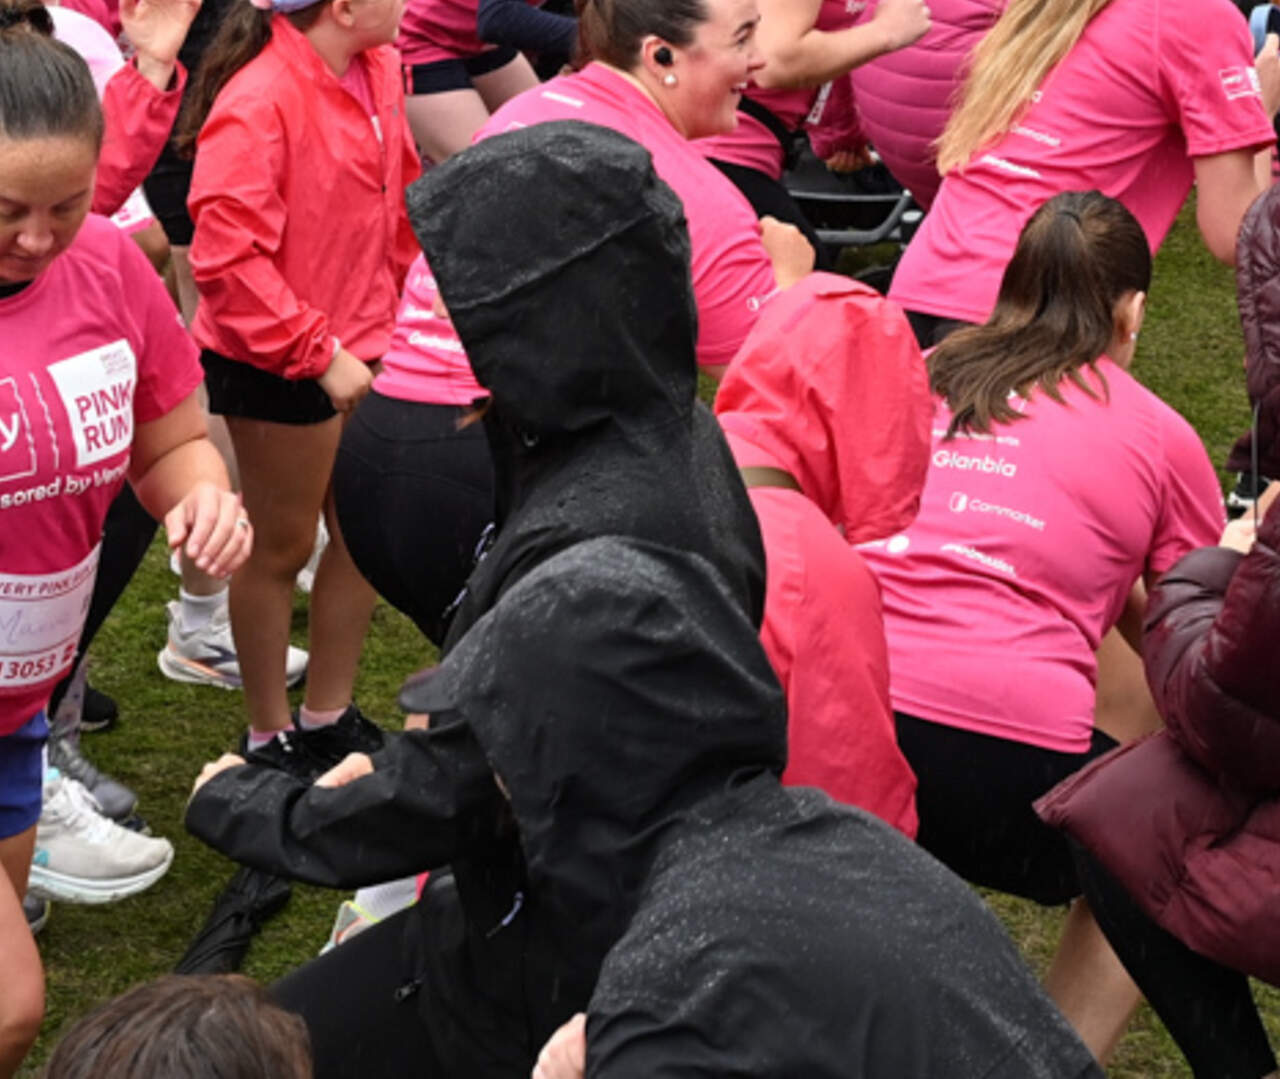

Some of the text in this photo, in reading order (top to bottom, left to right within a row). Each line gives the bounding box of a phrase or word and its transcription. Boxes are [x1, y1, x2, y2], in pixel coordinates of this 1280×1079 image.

[74, 379, 132, 422] PINK
[83, 414, 131, 453] RUN
[932, 449, 1018, 478] Glanbia
[65, 474, 92, 495] by
[38, 578, 70, 595] PINK
